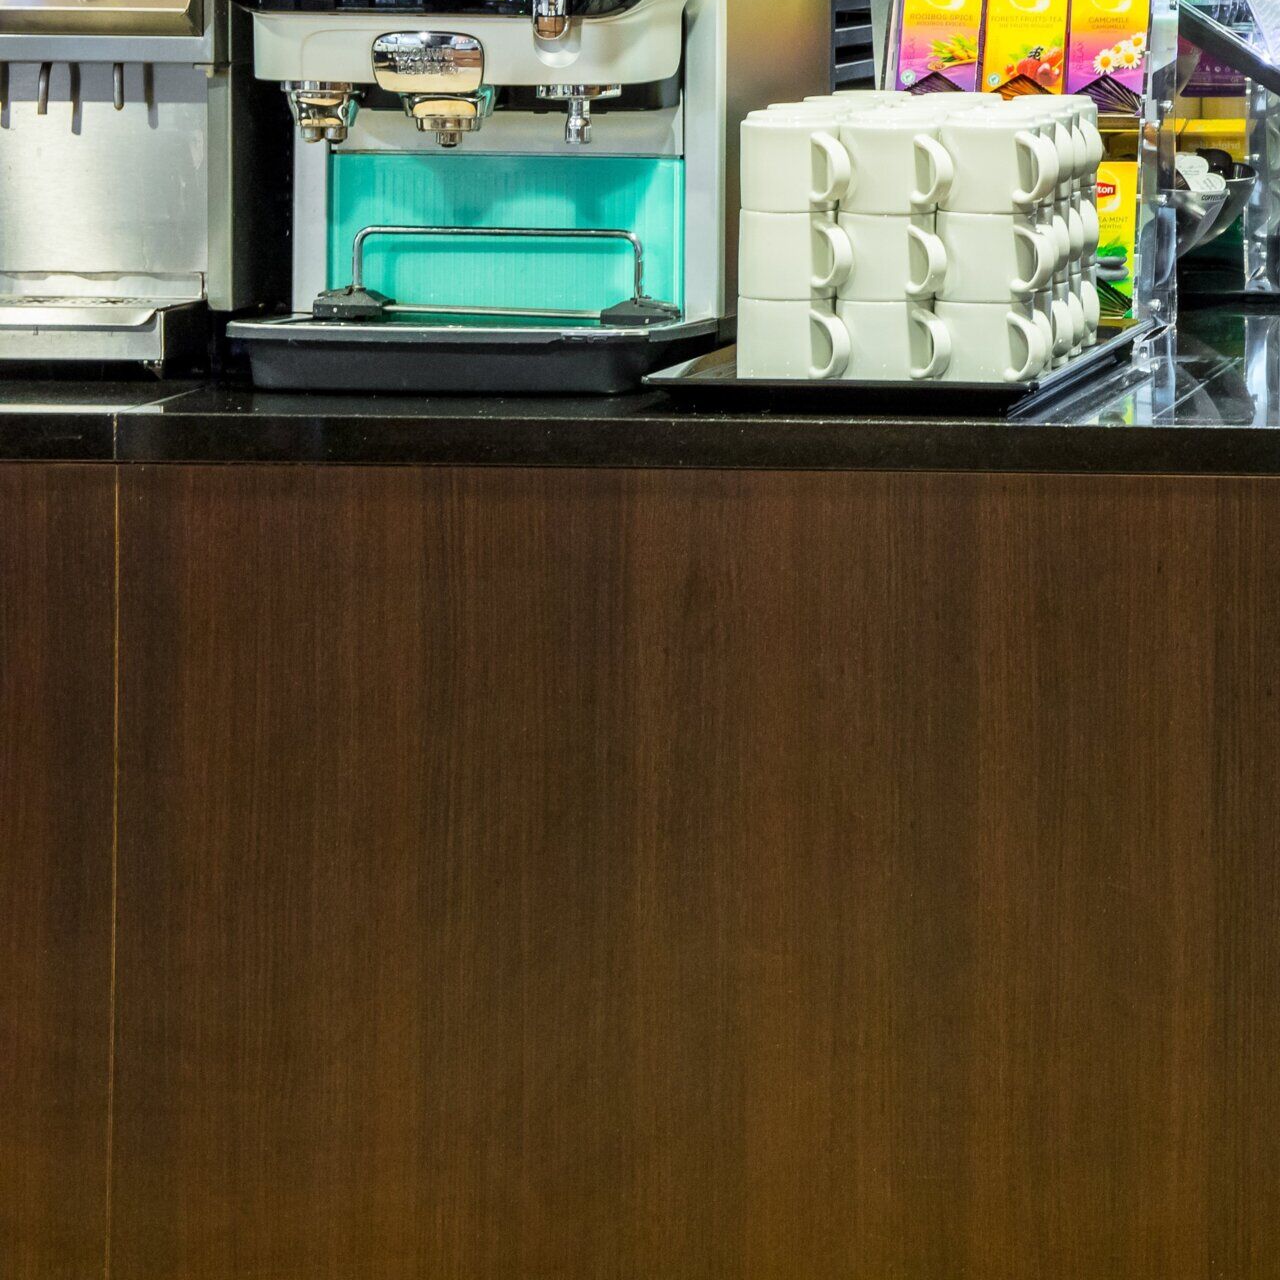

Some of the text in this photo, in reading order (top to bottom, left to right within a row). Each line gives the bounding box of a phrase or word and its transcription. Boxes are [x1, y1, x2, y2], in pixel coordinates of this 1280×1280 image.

[909, 13, 947, 21] ROOIBOS
[990, 15, 1064, 23] FOREST FRUITS TEA
[1088, 16, 1129, 24] CAMOMILE
[1097, 186, 1114, 195] ton
[1109, 215, 1129, 223] MINT
